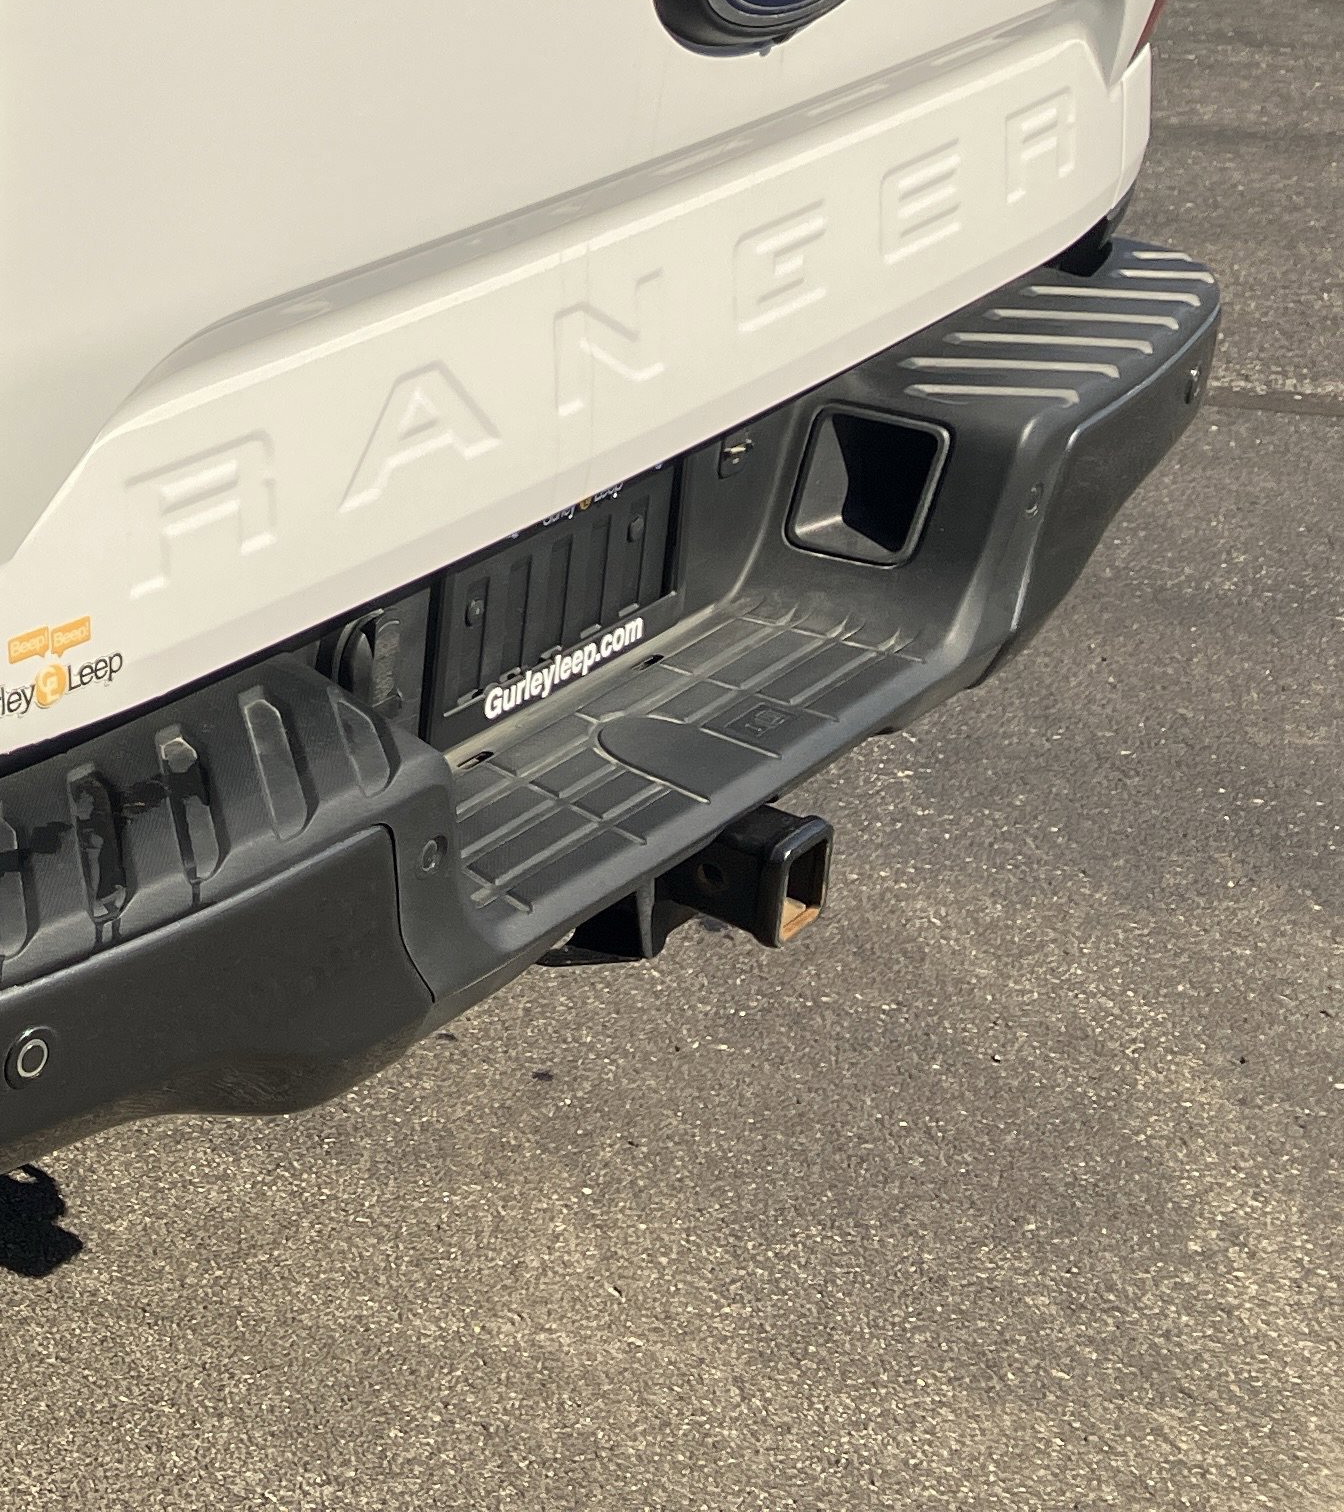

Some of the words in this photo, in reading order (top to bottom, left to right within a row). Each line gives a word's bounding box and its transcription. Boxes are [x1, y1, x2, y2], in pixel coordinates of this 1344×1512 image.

[123, 85, 1079, 602] RANGER
[10, 630, 49, 657] Beep!
[52, 621, 90, 648] Beep!
[68, 652, 123, 692] Leep
[484, 617, 644, 720] Gurleyleep.com
